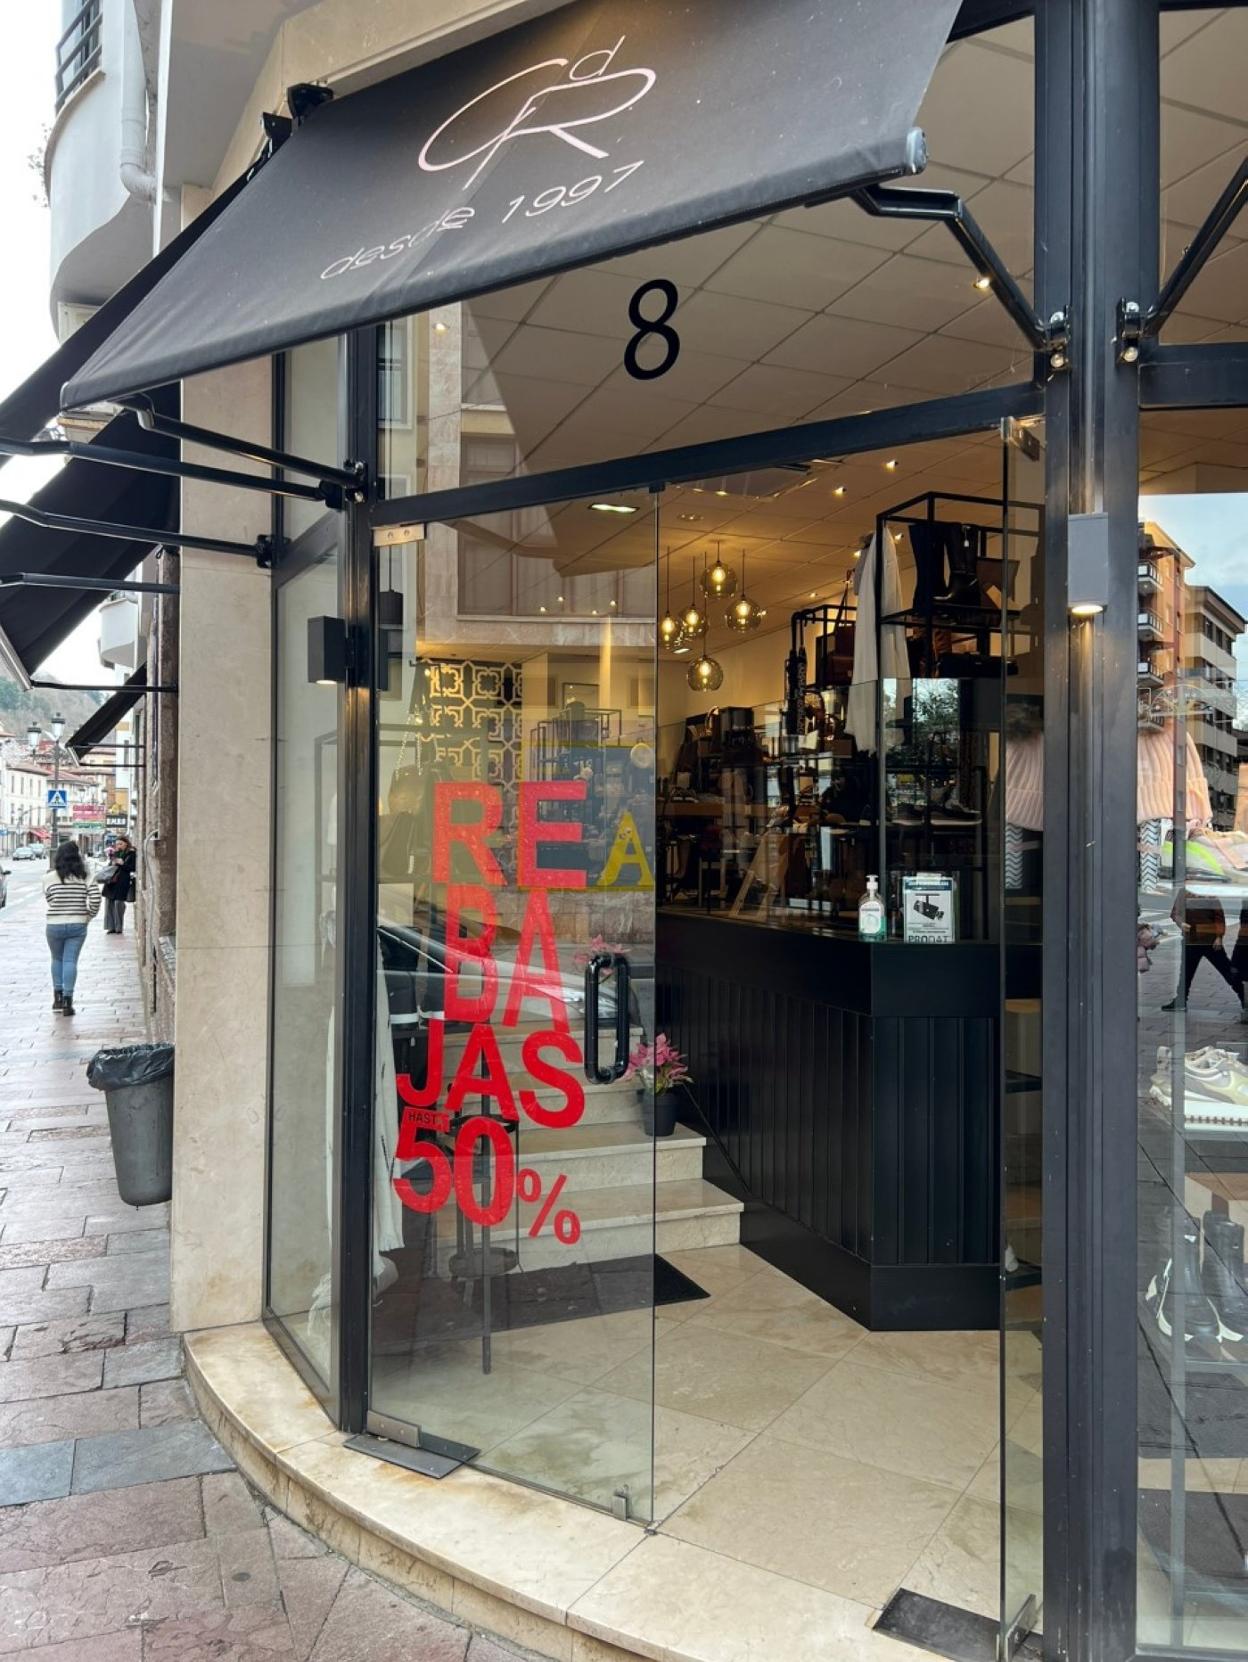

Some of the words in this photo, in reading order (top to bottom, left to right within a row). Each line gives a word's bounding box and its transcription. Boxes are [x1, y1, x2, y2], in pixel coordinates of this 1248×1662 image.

[320, 206, 475, 279] desde
[502, 160, 644, 223] 1997
[623, 278, 680, 380] 8
[396, 1018, 585, 1129] JAS
